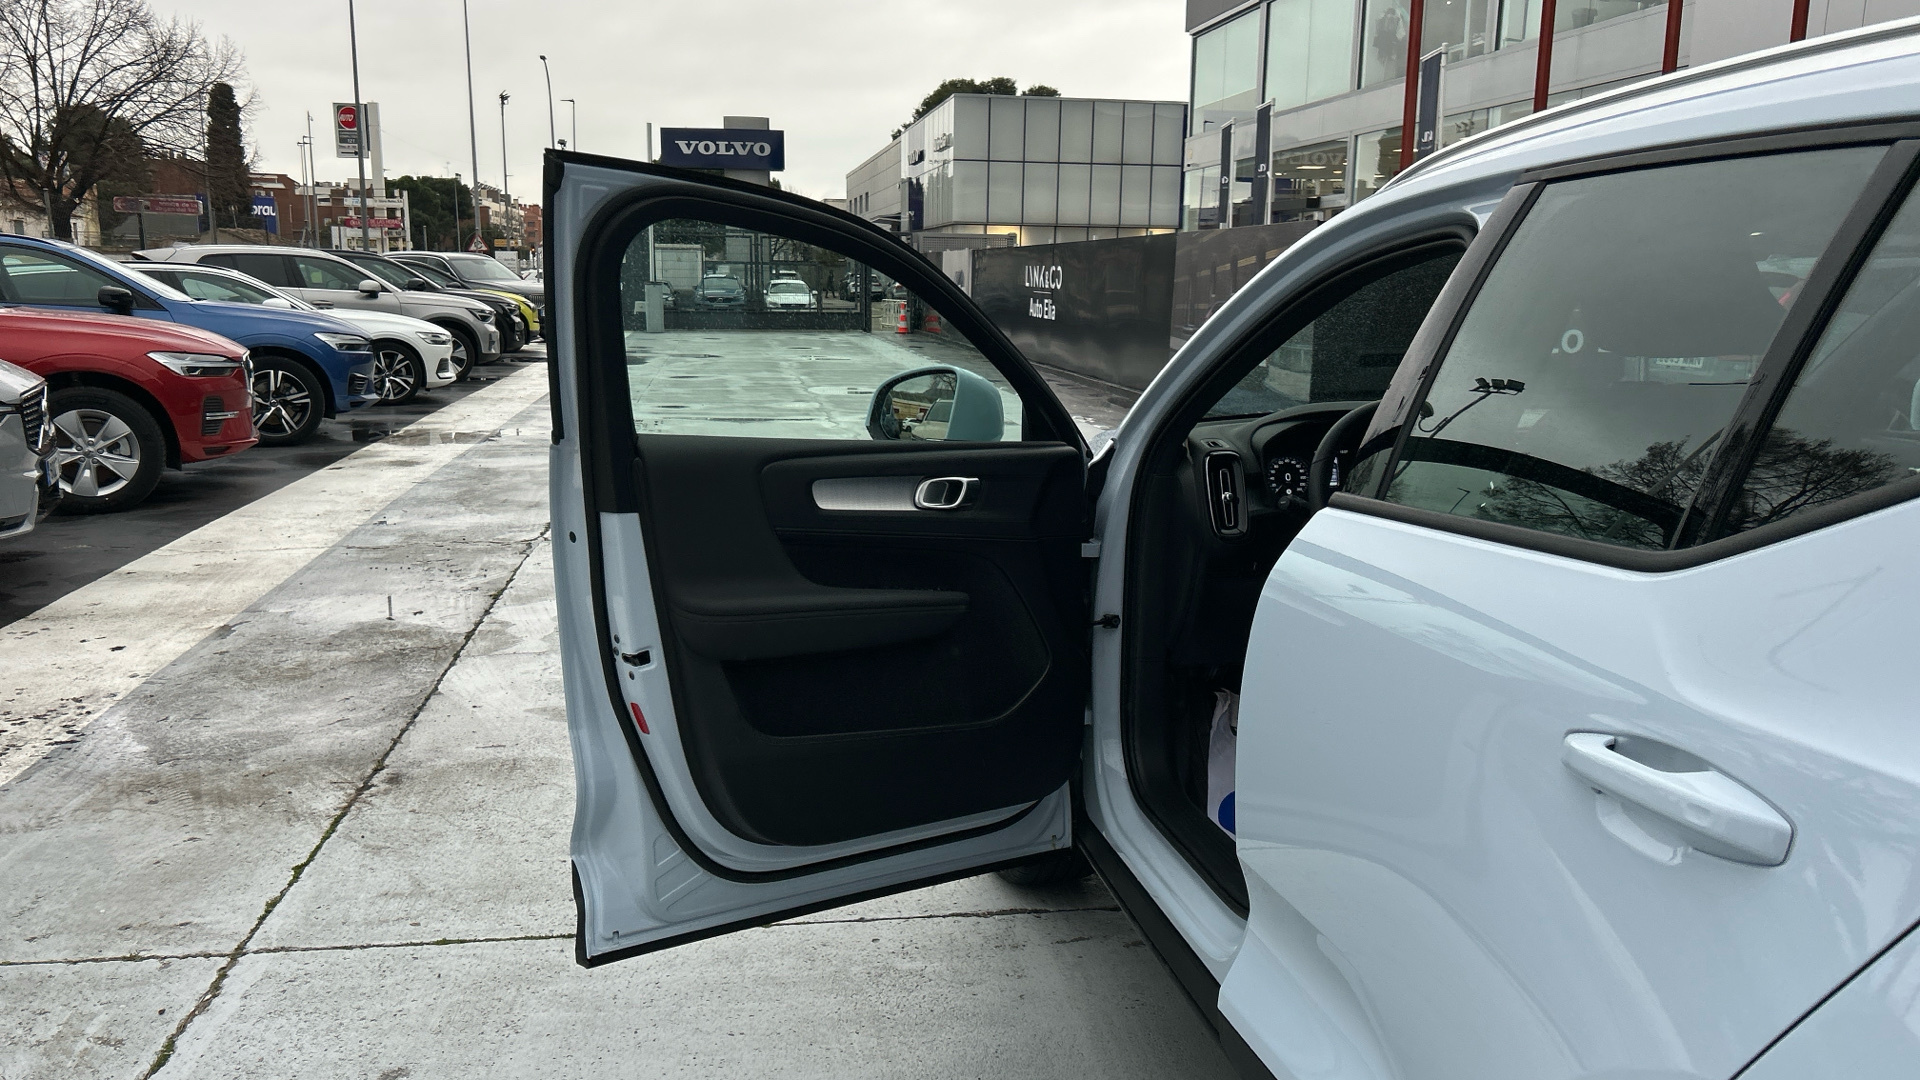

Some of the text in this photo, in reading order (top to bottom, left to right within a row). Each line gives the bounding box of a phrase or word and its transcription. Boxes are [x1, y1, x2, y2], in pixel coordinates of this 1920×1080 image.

[675, 141, 771, 157] VOLVO
[1029, 297, 1056, 320] Auto Elia
